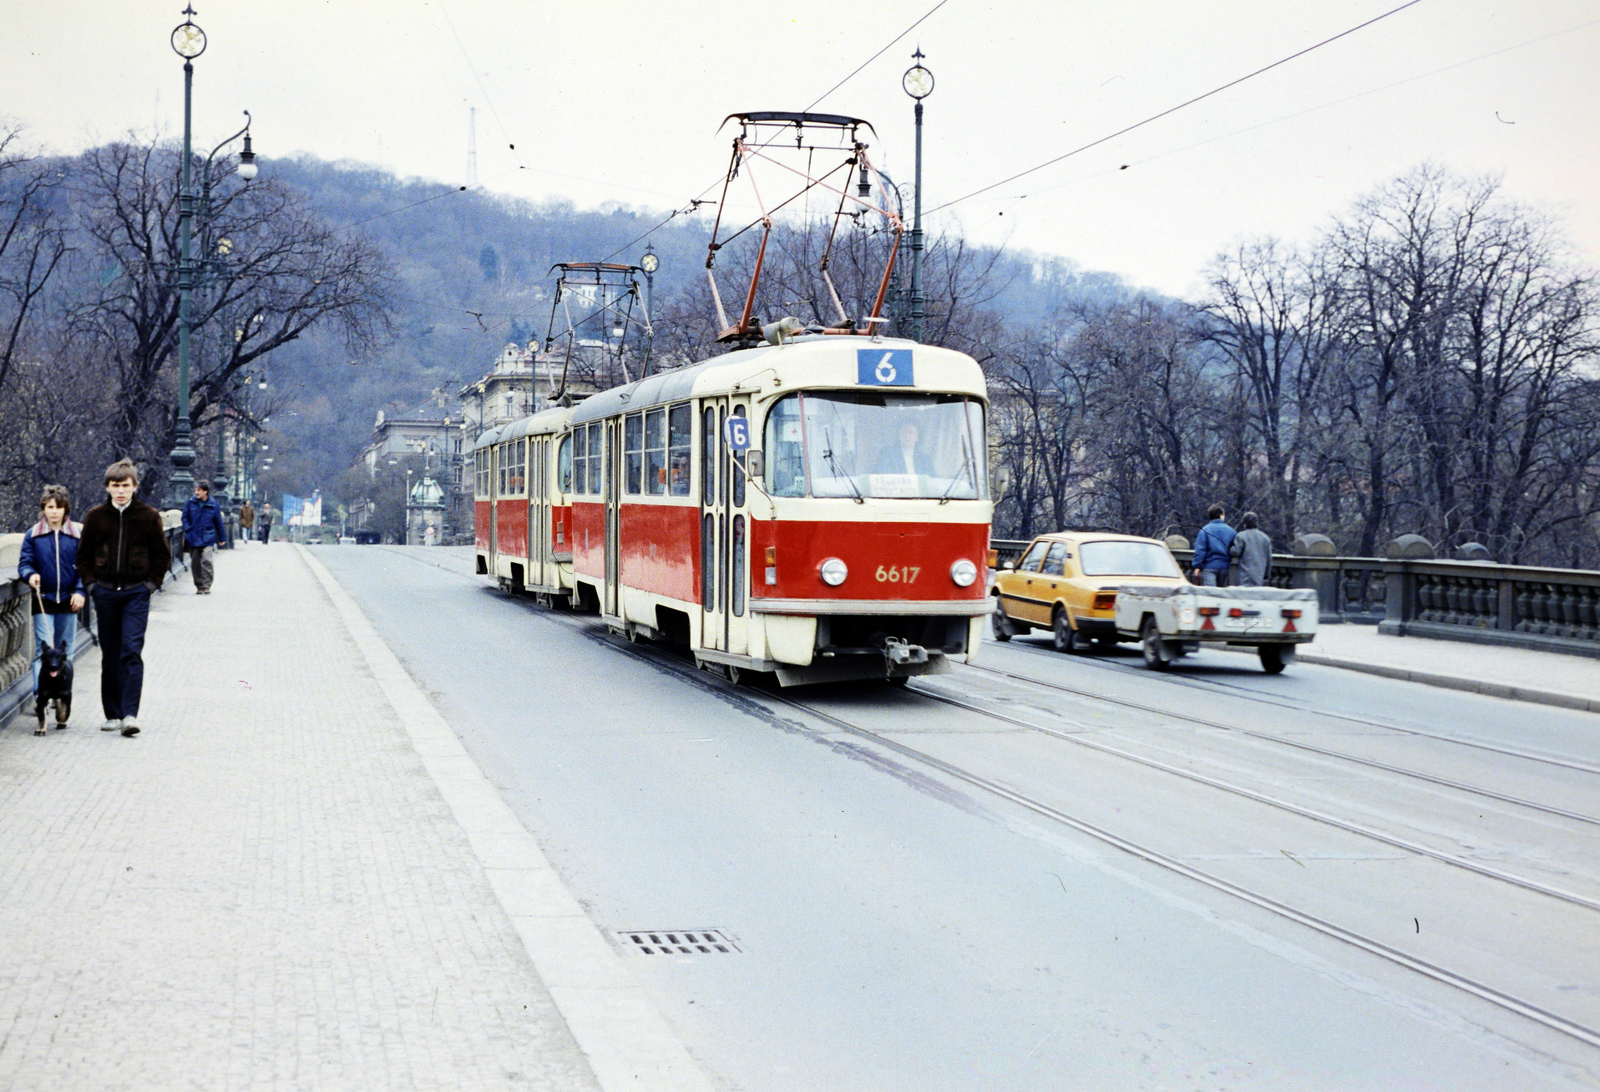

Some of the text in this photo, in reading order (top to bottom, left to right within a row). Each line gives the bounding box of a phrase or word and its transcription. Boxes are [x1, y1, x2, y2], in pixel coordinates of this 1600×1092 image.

[875, 352, 896, 383] 6
[733, 424, 746, 446] 6
[875, 565, 921, 584] 6617
